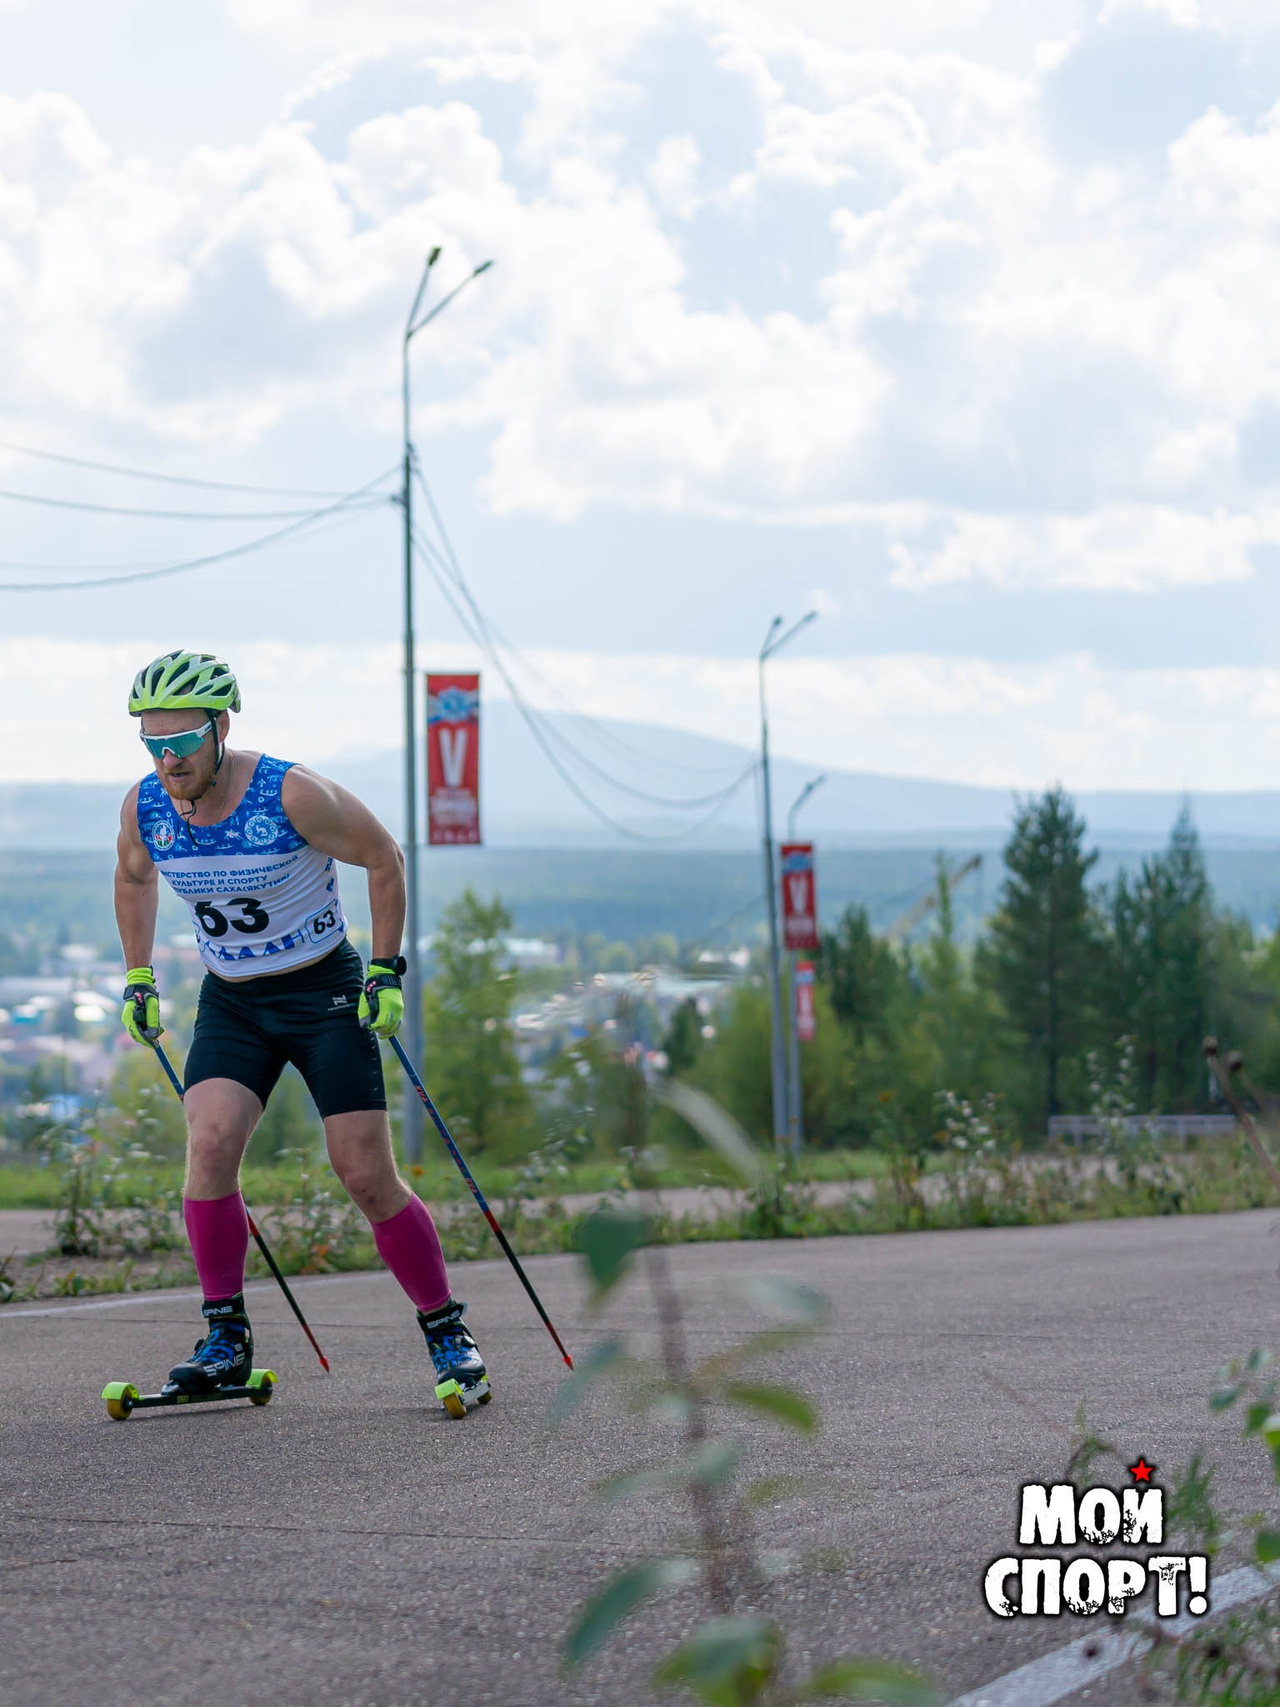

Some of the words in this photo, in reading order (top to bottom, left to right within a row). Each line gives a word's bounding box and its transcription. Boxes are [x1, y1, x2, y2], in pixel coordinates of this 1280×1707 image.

[213, 870, 228, 878] ПО
[229, 854, 298, 877] ФИЗИЧЕСКОЙ
[171, 879, 216, 887] КУЛЬТУРЕ
[218, 878, 225, 886] И
[227, 875, 267, 885] СПОРТУ
[194, 897, 269, 937] 63
[313, 909, 336, 934] 63
[203, 1305, 233, 1316] SPINE
[426, 1309, 460, 1329] SPINE
[202, 1352, 246, 1377] SPINE
